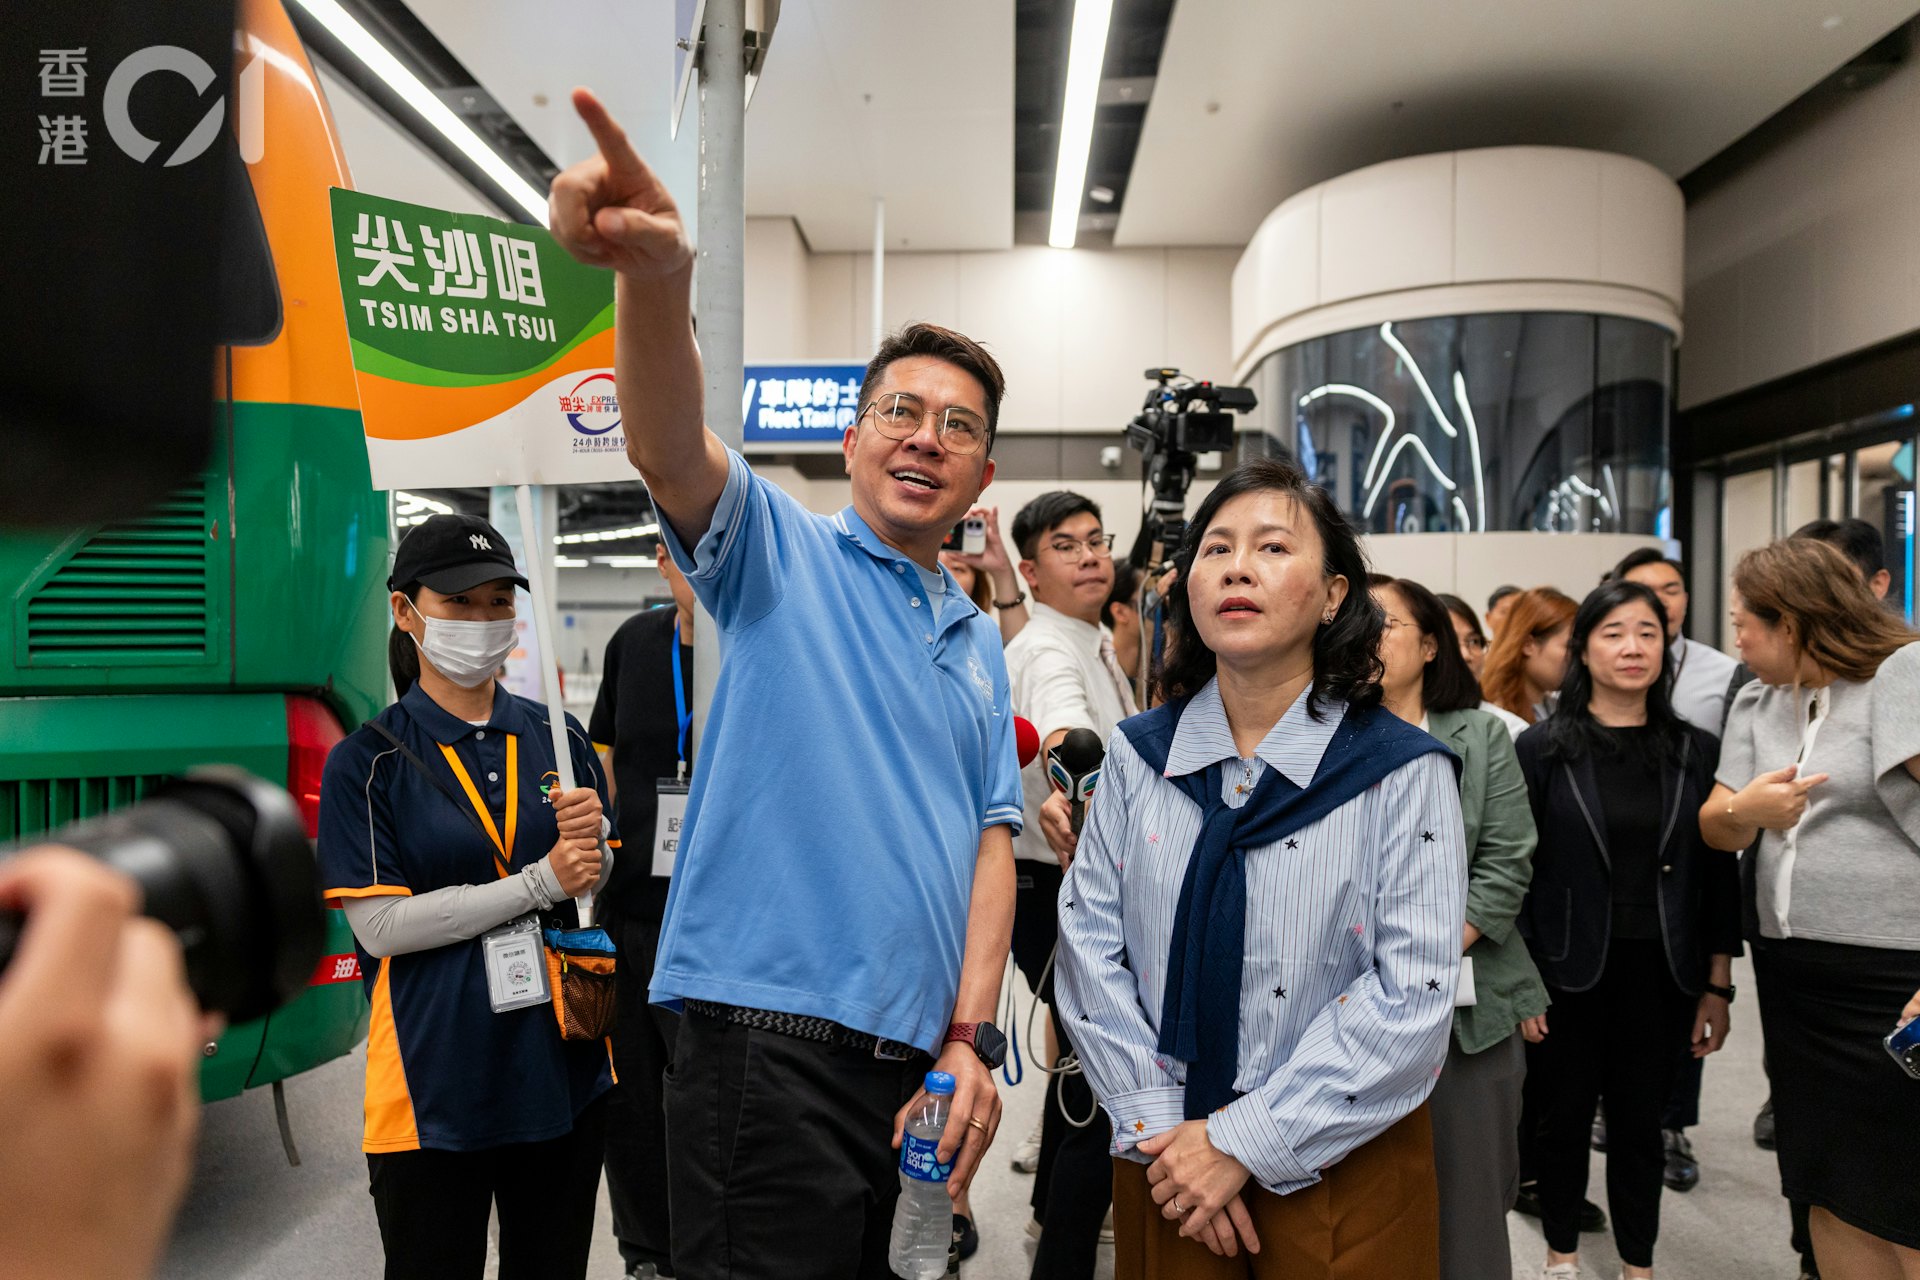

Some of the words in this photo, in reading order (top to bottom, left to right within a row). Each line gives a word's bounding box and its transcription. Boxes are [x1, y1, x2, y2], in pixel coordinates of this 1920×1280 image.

[352, 213, 546, 307] 尖沙咀
[360, 299, 433, 331] TSIM
[440, 307, 499, 335] SHA
[502, 312, 556, 342] TSUI
[559, 396, 586, 412] 油尖
[469, 534, 492, 550] NY
[332, 957, 361, 979] 油
